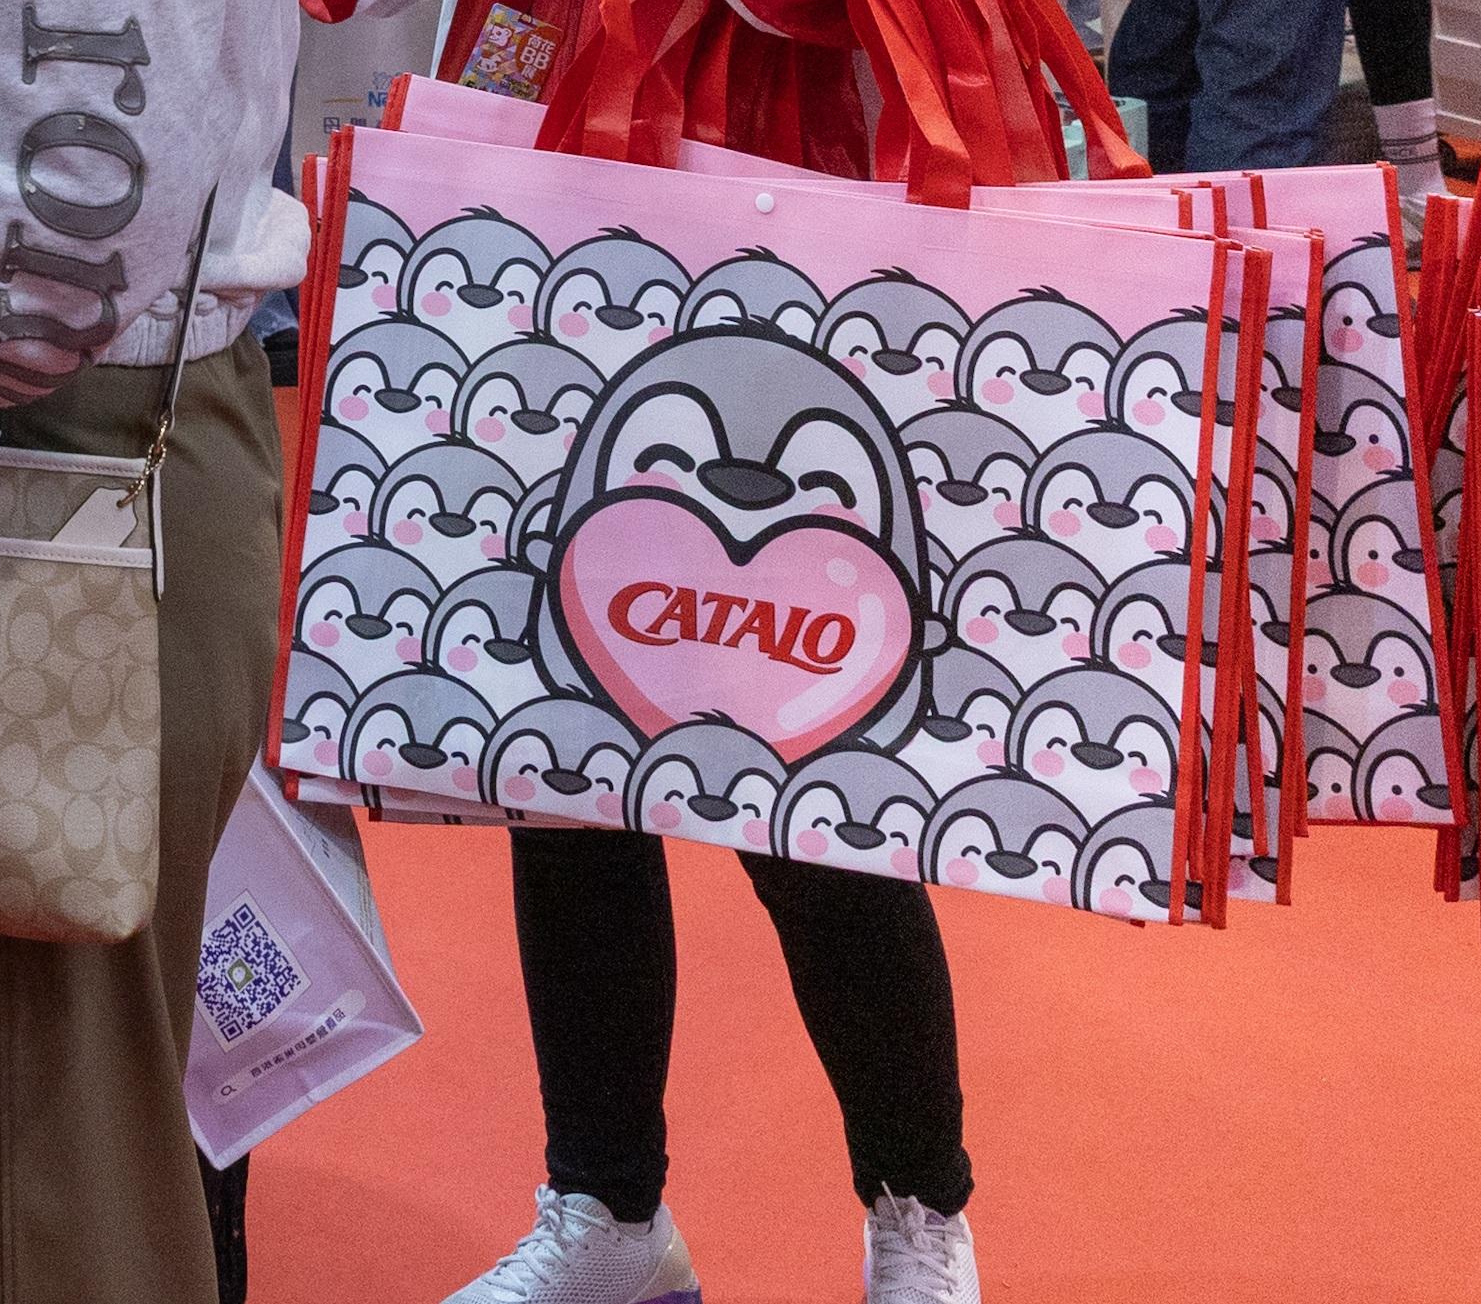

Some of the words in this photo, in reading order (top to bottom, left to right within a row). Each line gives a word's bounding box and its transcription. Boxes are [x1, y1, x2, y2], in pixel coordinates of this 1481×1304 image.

[527, 33, 555, 54] 荷花
[520, 44, 550, 71] BB
[607, 579, 857, 676] CATALO
